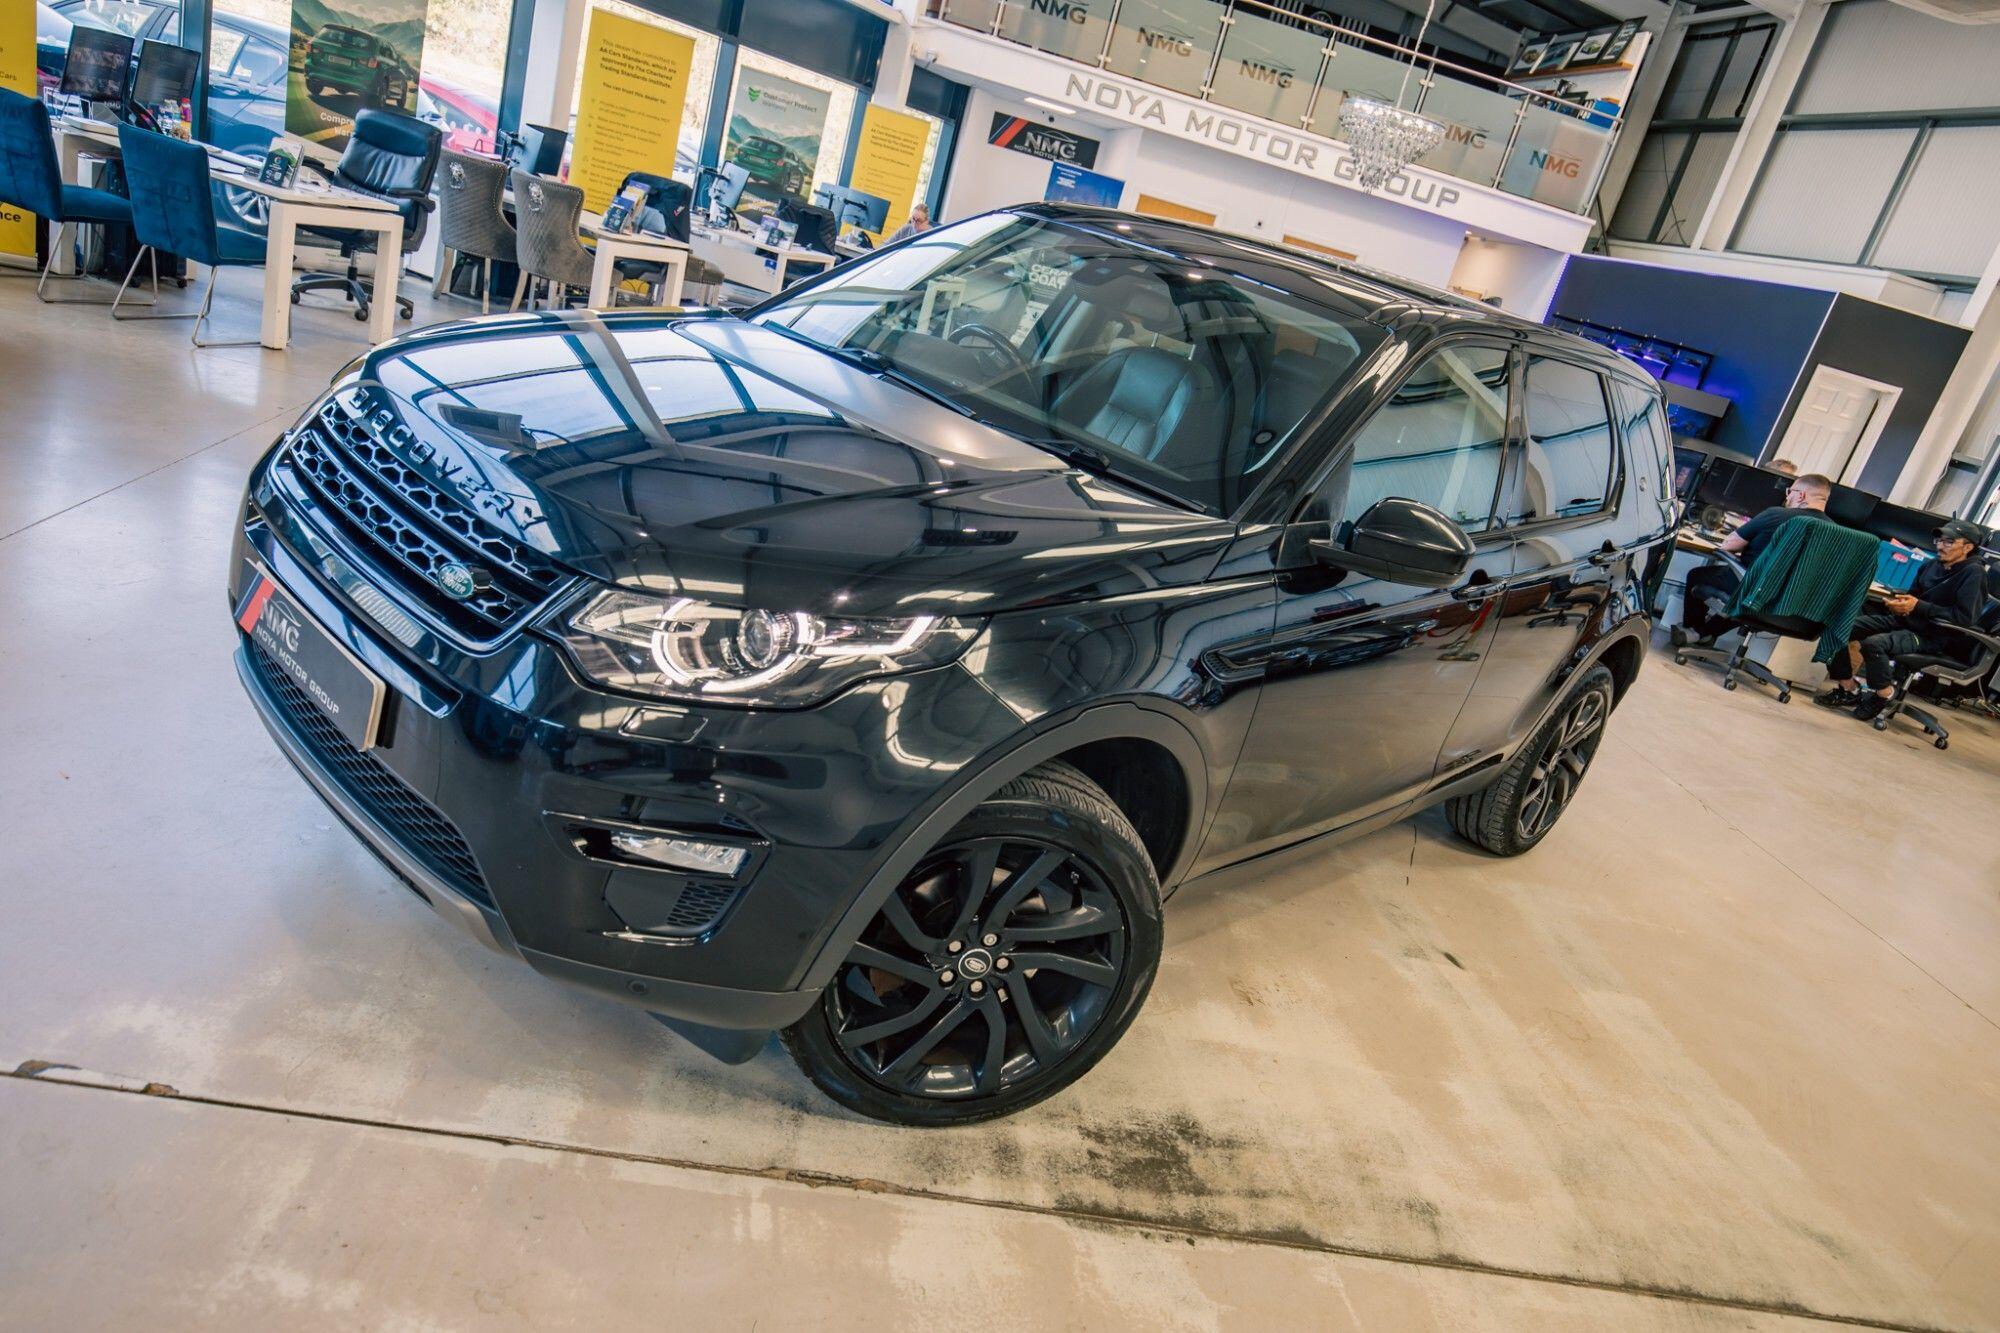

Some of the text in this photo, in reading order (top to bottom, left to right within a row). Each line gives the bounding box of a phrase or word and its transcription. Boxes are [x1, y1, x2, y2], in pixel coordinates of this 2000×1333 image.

[1030, 0, 1087, 25] NMG
[1136, 27, 1192, 57] NMG
[1238, 59, 1294, 89] NMG
[1024, 131, 1076, 159] NMG
[1065, 73, 1460, 208] NOYA MOTOR GOUP
[1529, 150, 1580, 178] NMG
[349, 386, 549, 530] DISCOVERY
[259, 596, 300, 653] NMG
[256, 624, 340, 714] NOYA MOTOR GROUP
